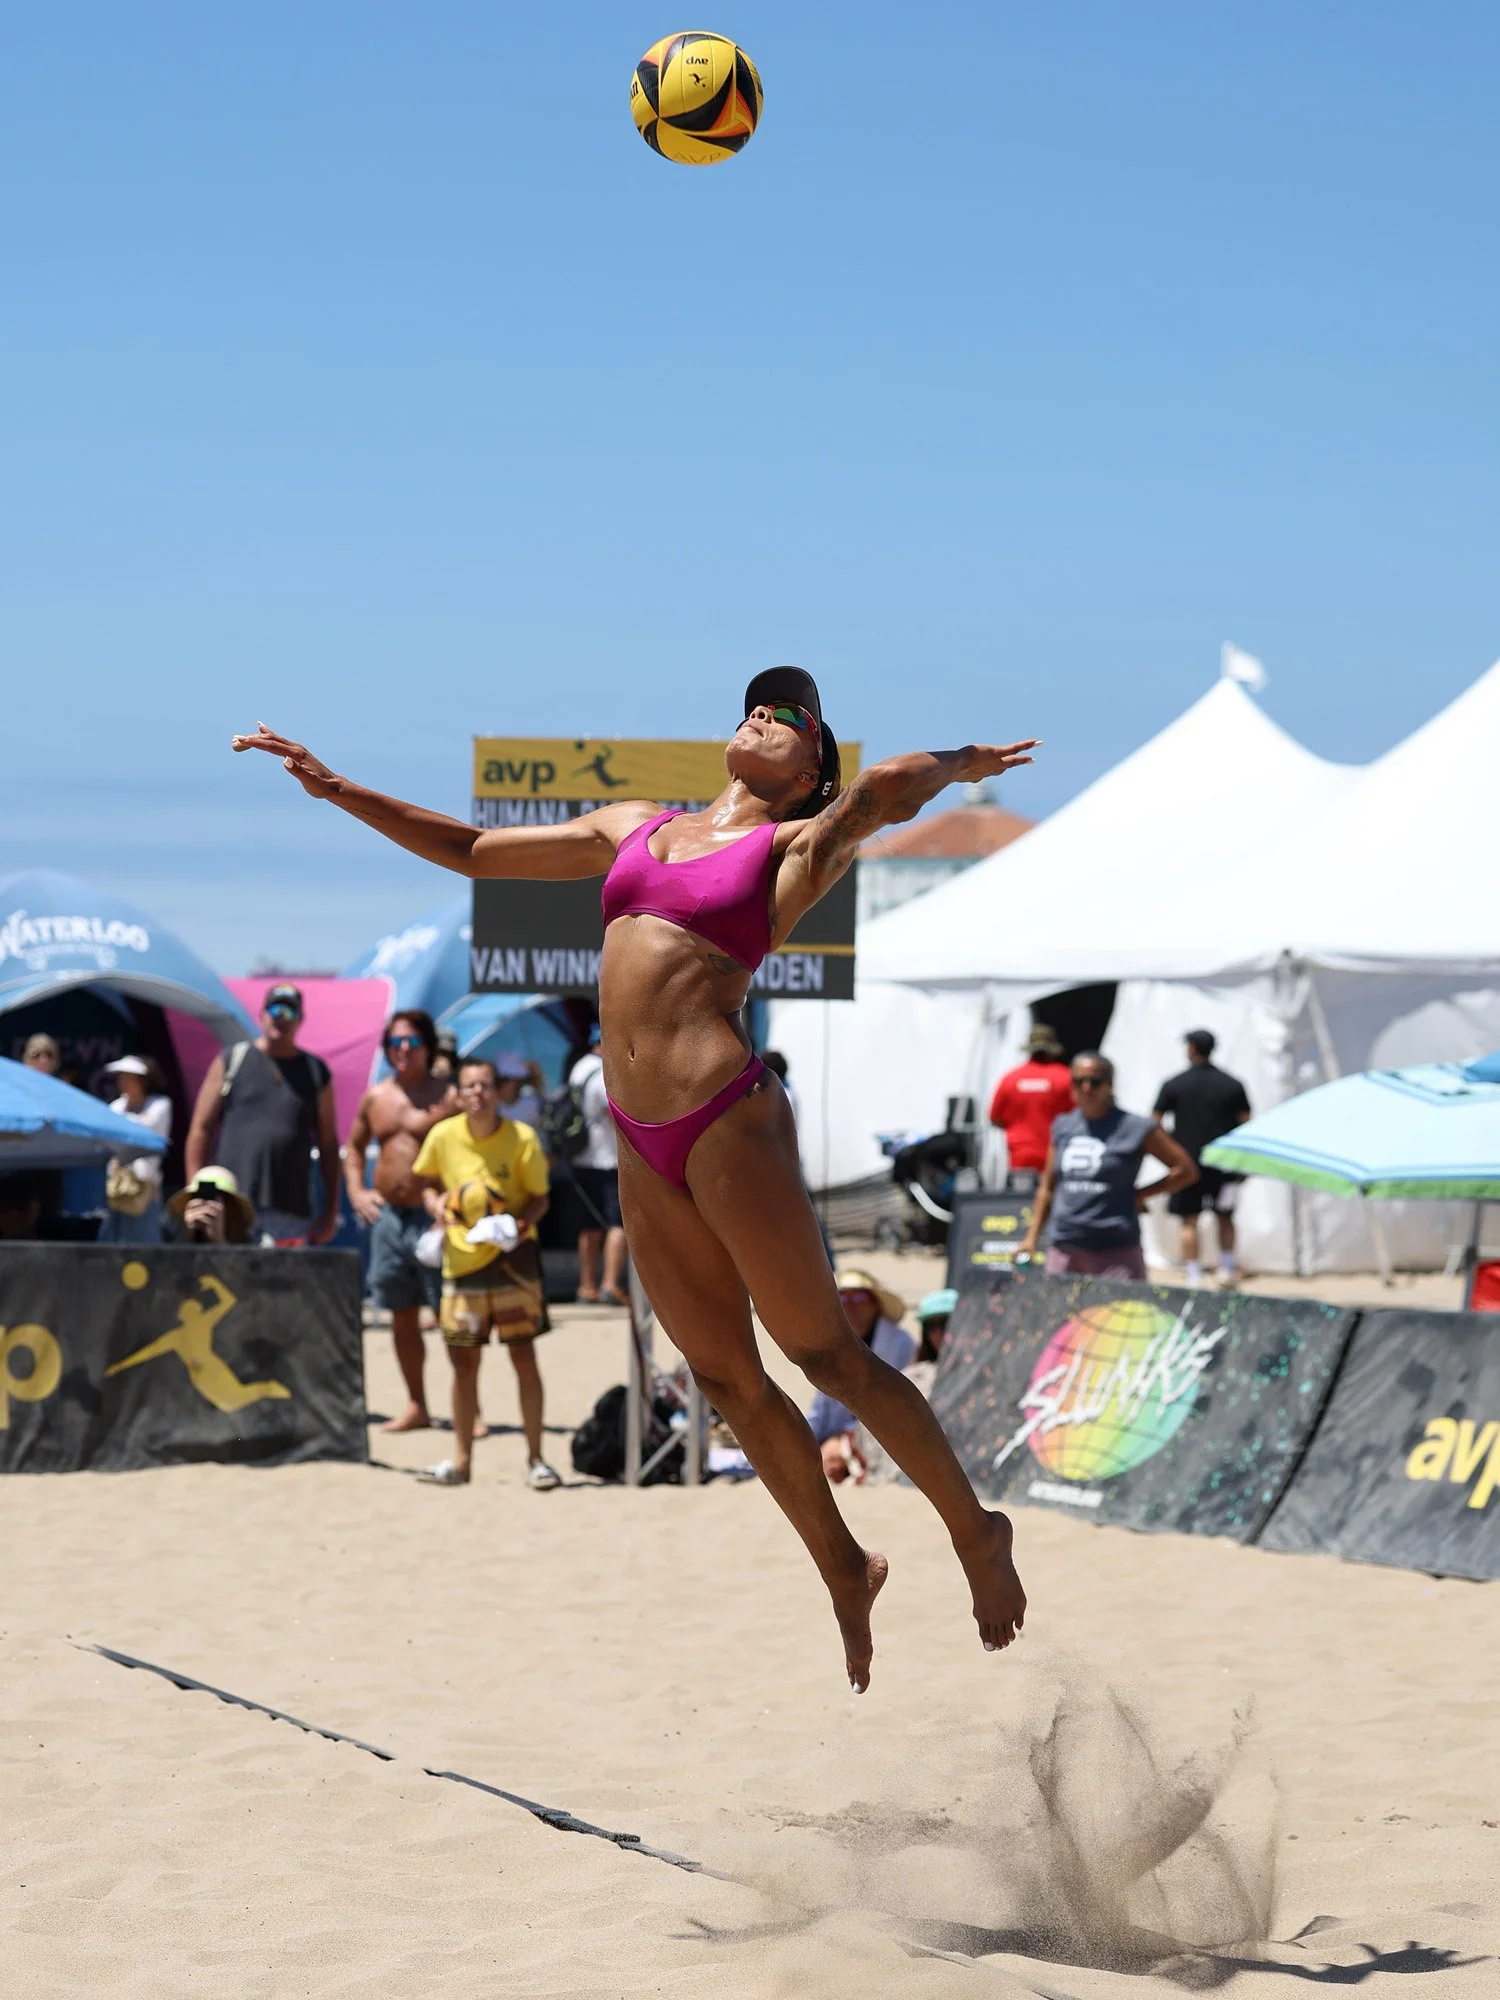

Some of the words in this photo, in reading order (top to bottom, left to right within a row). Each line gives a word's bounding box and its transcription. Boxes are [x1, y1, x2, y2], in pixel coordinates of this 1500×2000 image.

[685, 56, 709, 65] avp
[482, 756, 556, 792] avp
[475, 798, 570, 829] HUMANA
[0, 908, 150, 966] WATERLOO
[471, 947, 527, 985] VAN
[531, 948, 602, 987] WINK
[751, 953, 824, 991] NDEN
